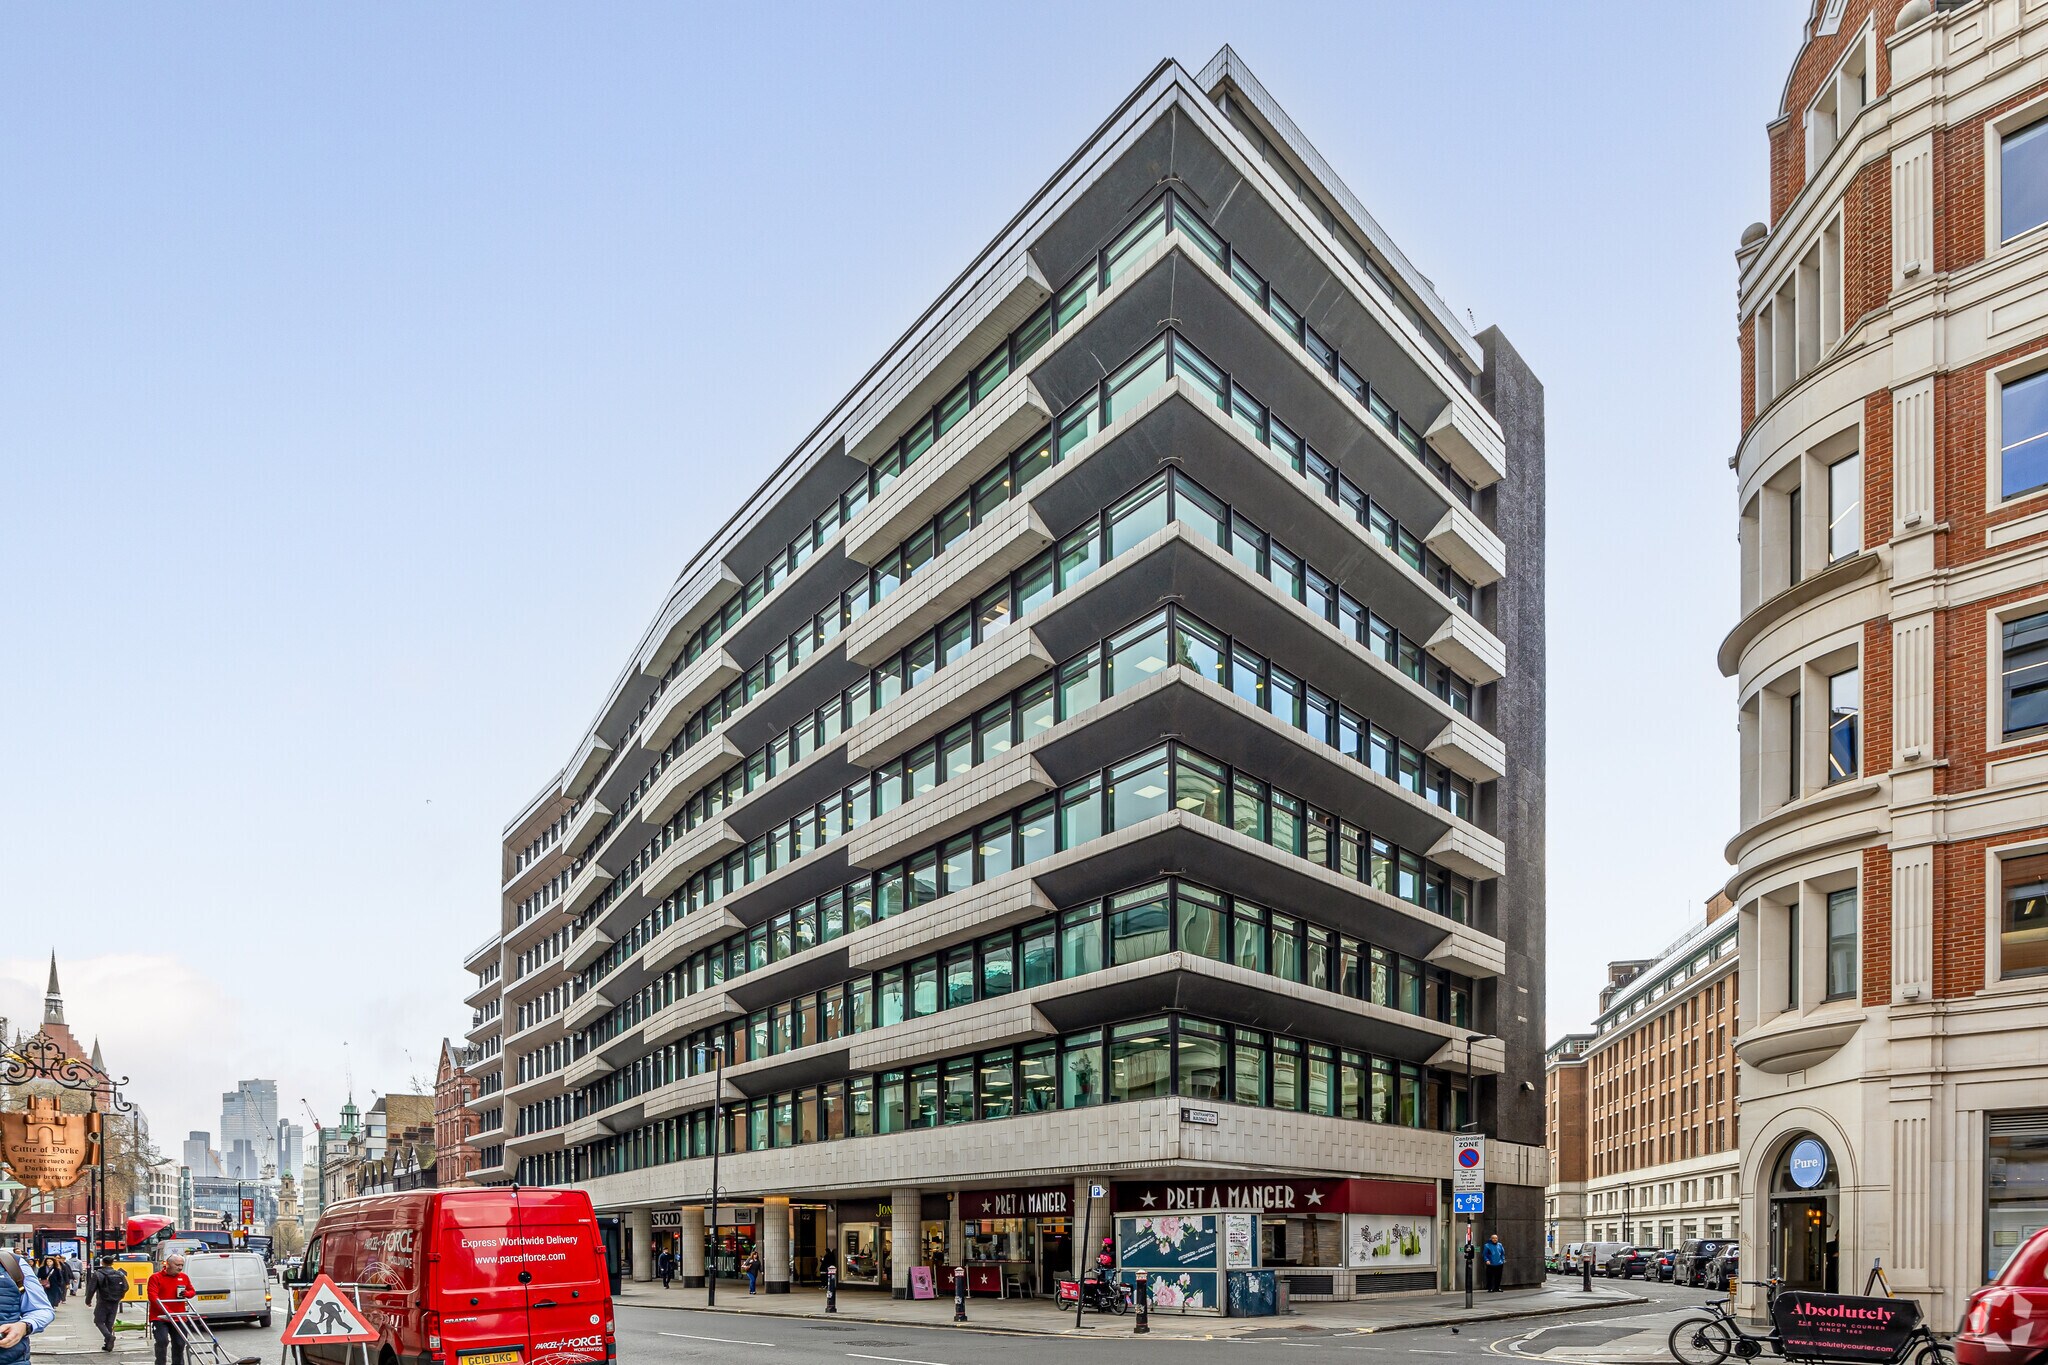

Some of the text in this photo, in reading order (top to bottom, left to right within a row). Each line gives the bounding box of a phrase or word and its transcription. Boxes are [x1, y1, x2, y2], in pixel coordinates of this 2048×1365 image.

[52, 1146, 79, 1154] Yorke
[1794, 1158, 1820, 1169] Pure.
[995, 1191, 1067, 1215] PRET A MANGER
[1166, 1185, 1295, 1209] PRET A MANGER
[876, 1203, 892, 1218] JON
[660, 1212, 681, 1226] FOOD
[384, 1229, 413, 1253] FORCE
[461, 1235, 578, 1249] Express Worldwide Delivery
[475, 1252, 566, 1265] www.parcelforce.com
[1790, 1302, 1896, 1325] Absolutely
[535, 1335, 603, 1350] PARCEL FORCE
[468, 1353, 512, 1365] GC18 UKG
